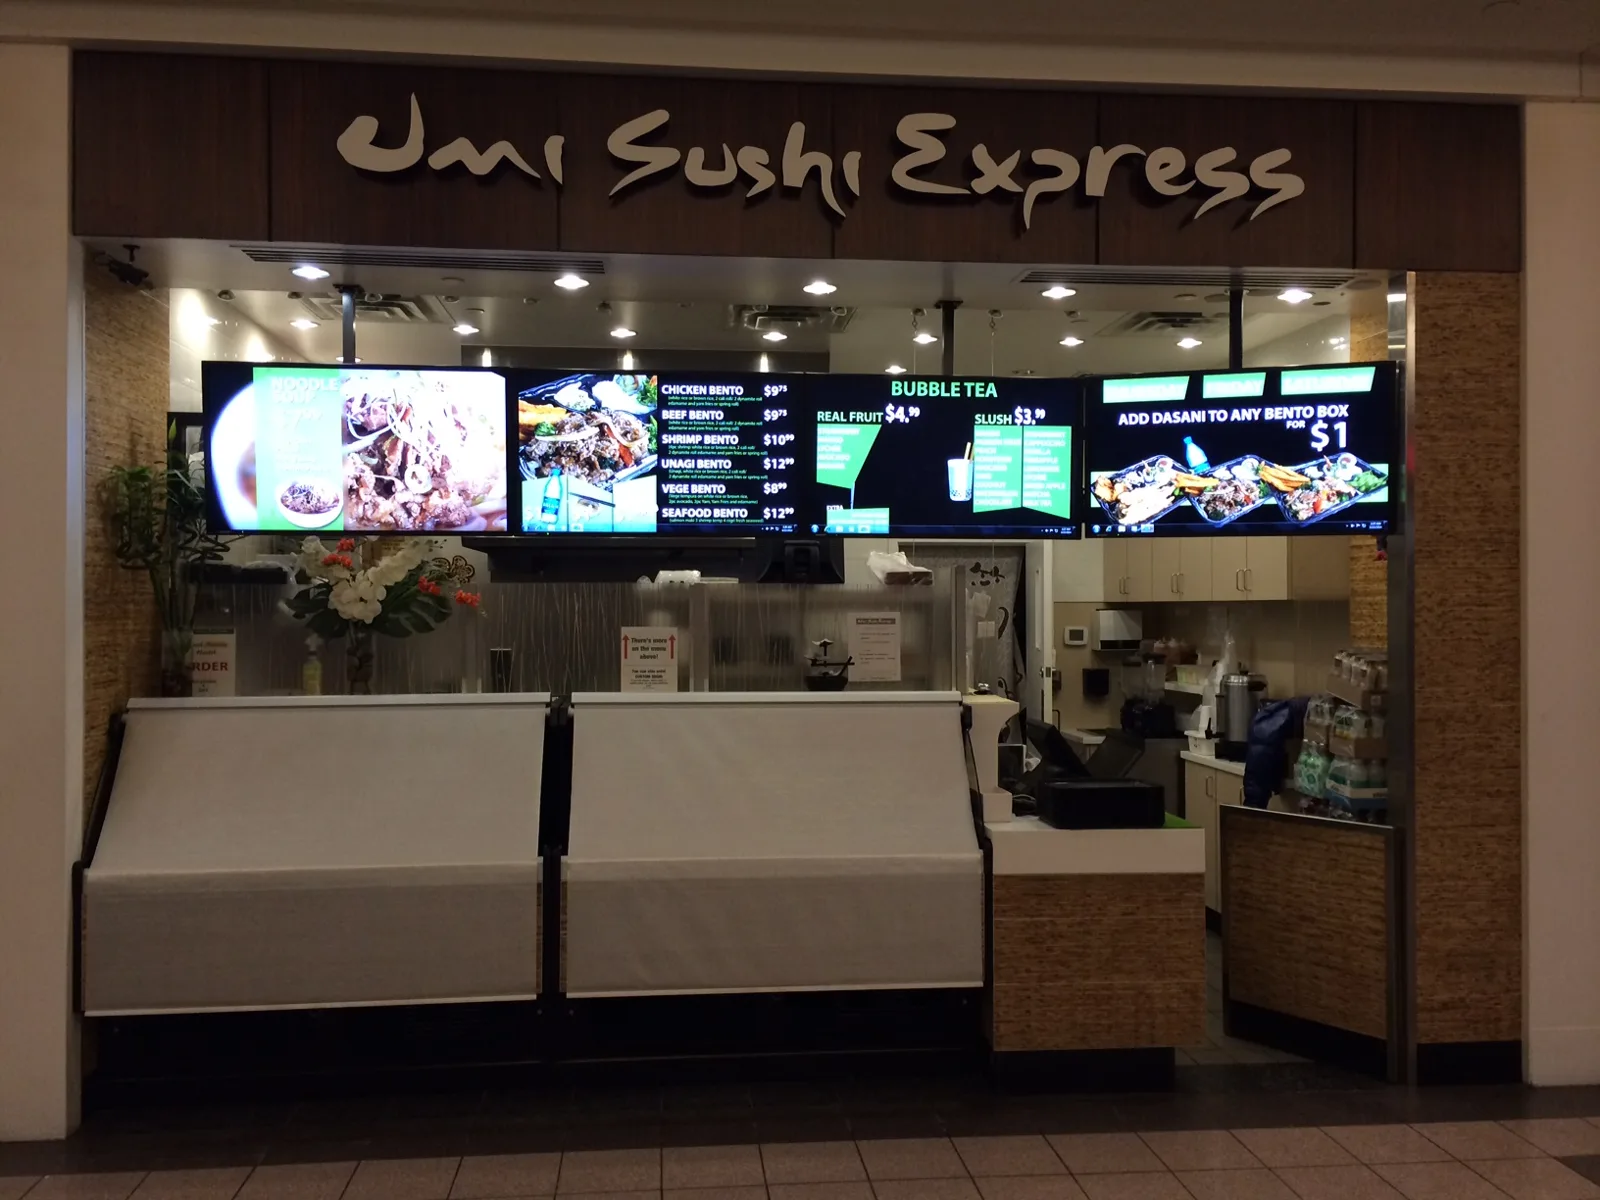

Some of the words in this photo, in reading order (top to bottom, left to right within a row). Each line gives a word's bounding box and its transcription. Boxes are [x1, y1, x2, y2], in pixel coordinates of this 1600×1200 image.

[607, 109, 861, 217] Sushi
[892, 112, 1305, 229] Express
[661, 385, 707, 395] CHICKEN
[709, 385, 744, 395] BENTO
[891, 381, 961, 397] BUBBLE
[964, 382, 998, 398] TEA
[661, 410, 688, 420] BEEF
[689, 410, 724, 420] BENTO
[817, 411, 847, 422] REAL
[849, 411, 883, 422] FRUIT
[974, 414, 1012, 425] SLUSH
[1118, 412, 1149, 426] ADD
[1152, 410, 1206, 424] DASANI
[1207, 409, 1228, 422] TO
[1230, 408, 1262, 421] ANY
[1264, 406, 1314, 420] BENTO
[1317, 404, 1350, 418] BOX
[661, 434, 702, 444] SHRIMP
[704, 434, 739, 444] BENTO
[1286, 420, 1306, 430] FOR
[1311, 420, 1347, 452] $1
[661, 459, 695, 469] UNAGI
[696, 460, 732, 470] BENTO
[662, 484, 689, 494] VEGE
[691, 484, 726, 494] BENTO
[662, 508, 712, 518] SEAFOOD
[714, 508, 748, 518] BENTO
